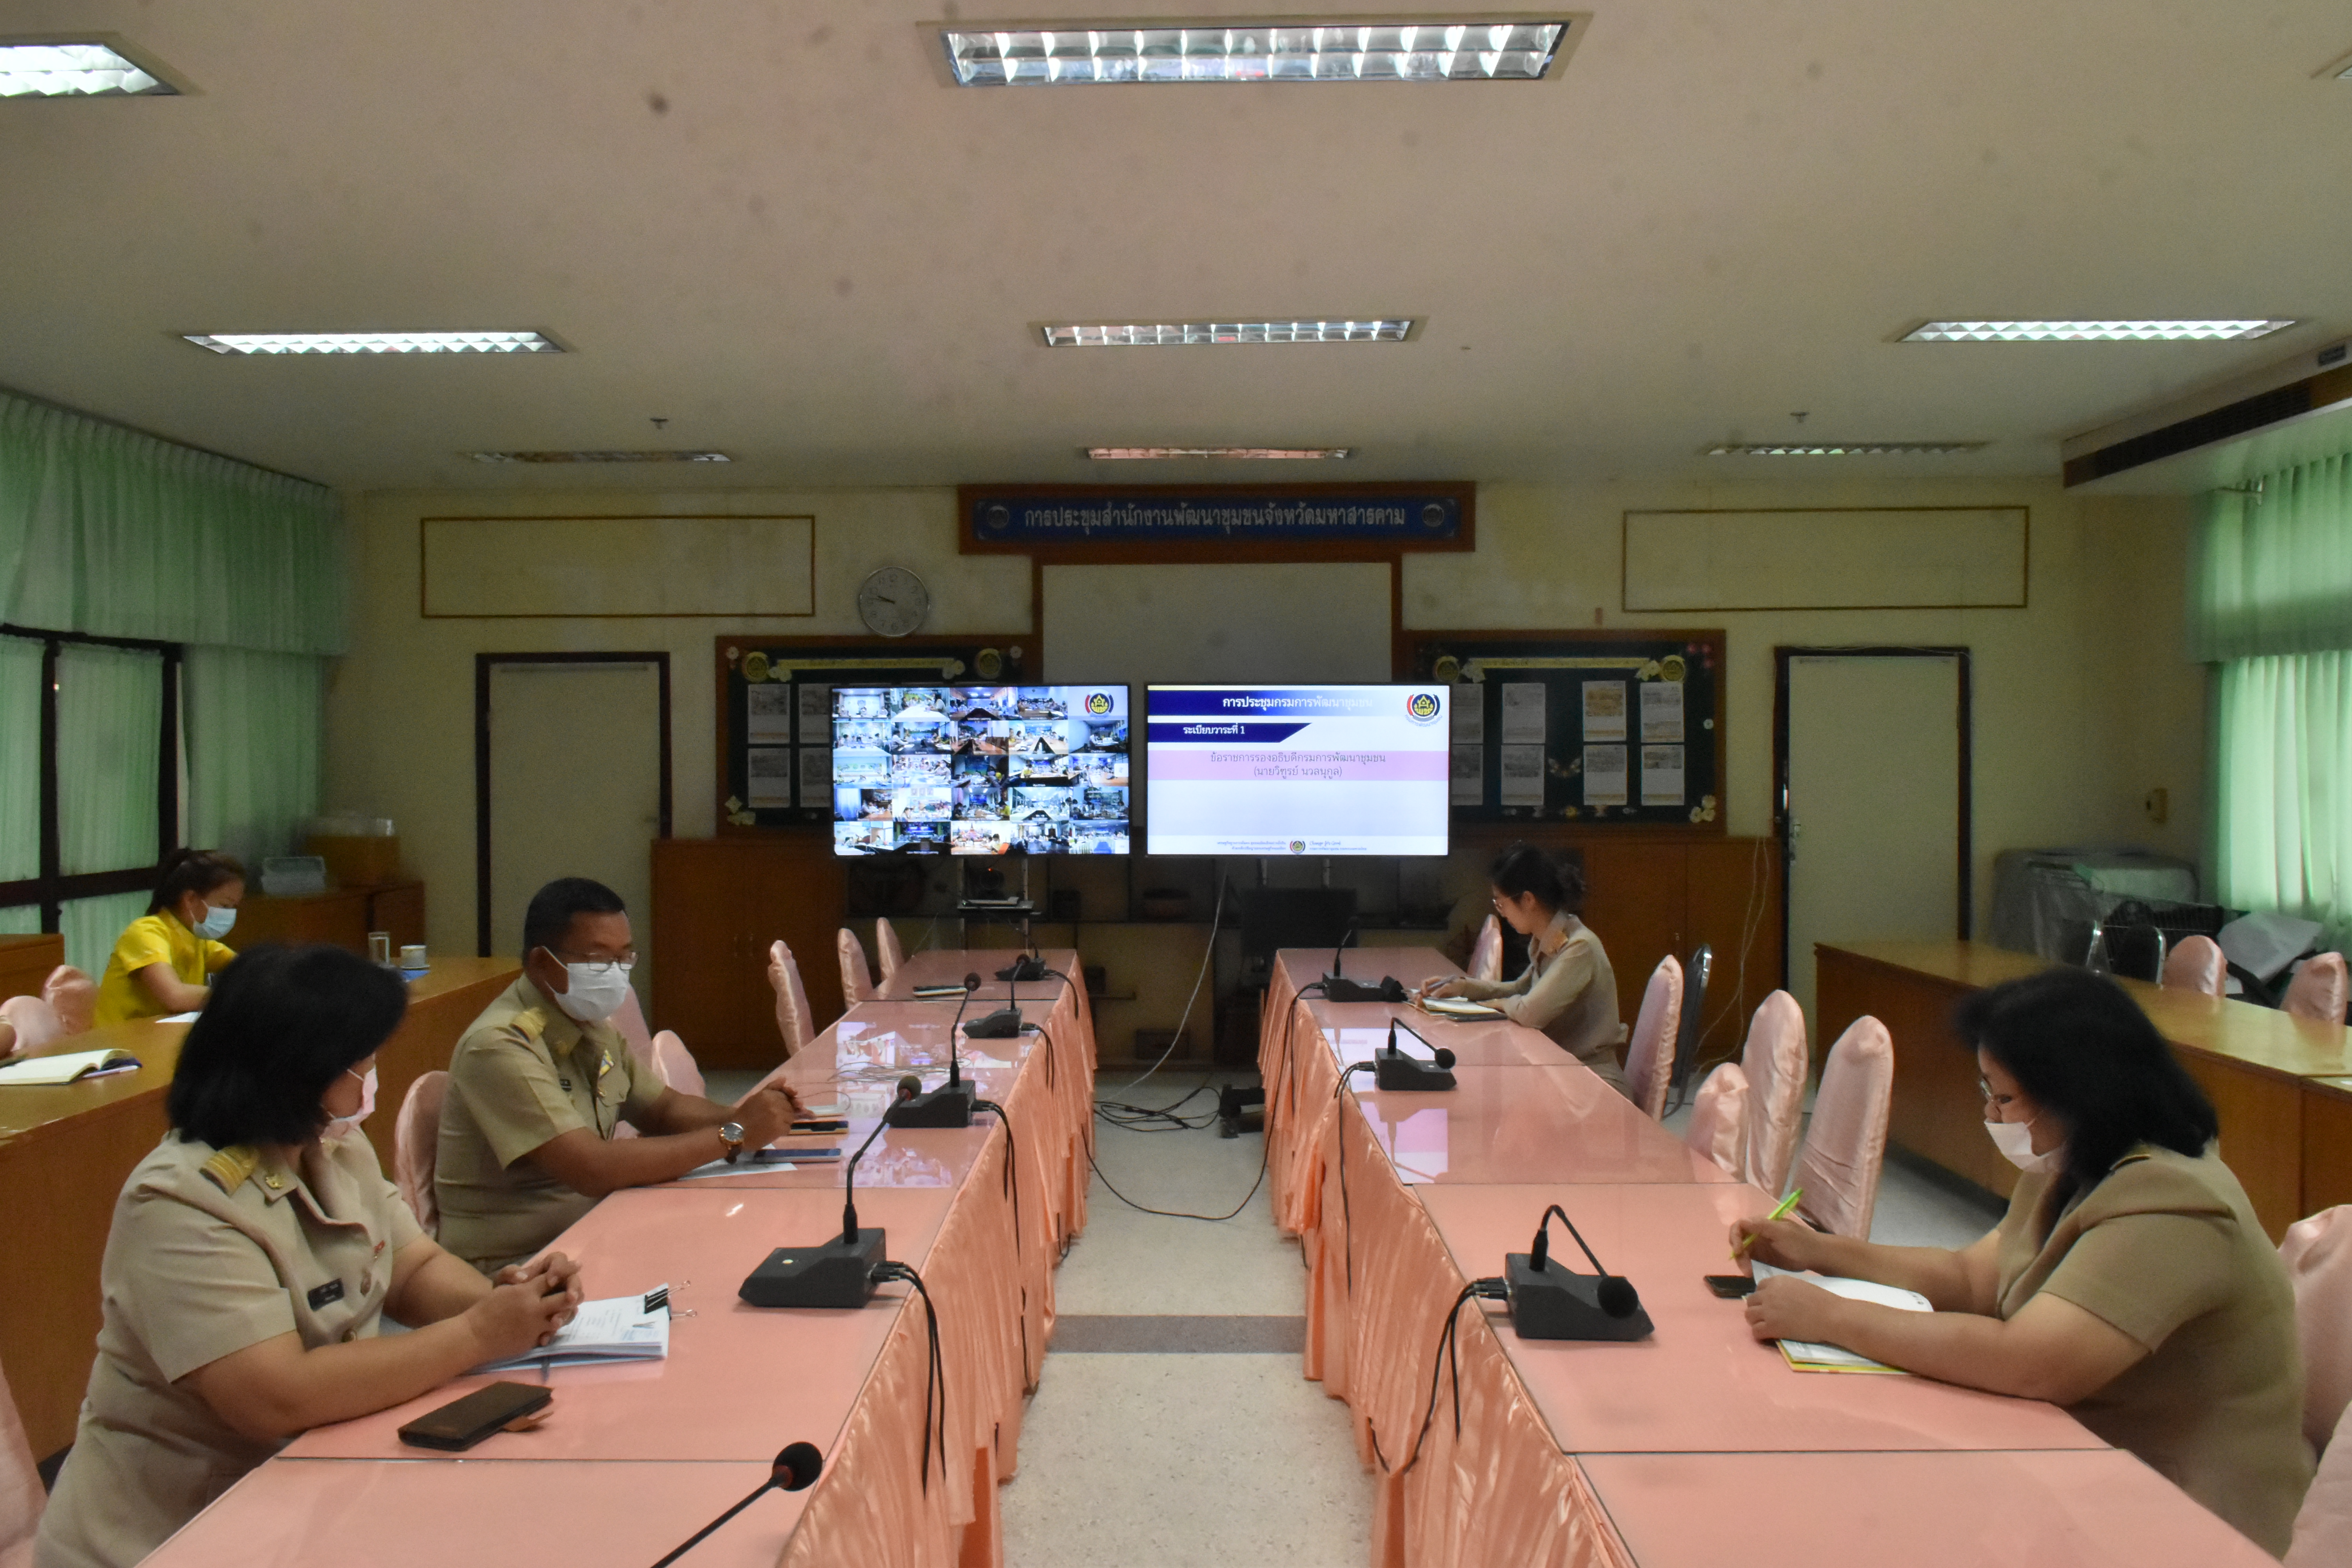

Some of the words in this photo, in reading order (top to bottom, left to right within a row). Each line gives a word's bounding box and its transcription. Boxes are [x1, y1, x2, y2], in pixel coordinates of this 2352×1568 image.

[1025, 501, 1405, 535] การประชุมสำนักงานพัฒนาชุมชนจังหวัดมหาสารคาม
[1223, 696, 1373, 711] การประชุมกรมการพัฒนาชุมชน
[1183, 723, 1238, 735] ระเบียบวาระที่
[1240, 726, 1245, 734] 1
[1210, 751, 1386, 764] ข้อราชการรองอธิบดีกรมการพัฒนาชุมชน
[1302, 766, 1343, 779] นวลนุกูล)
